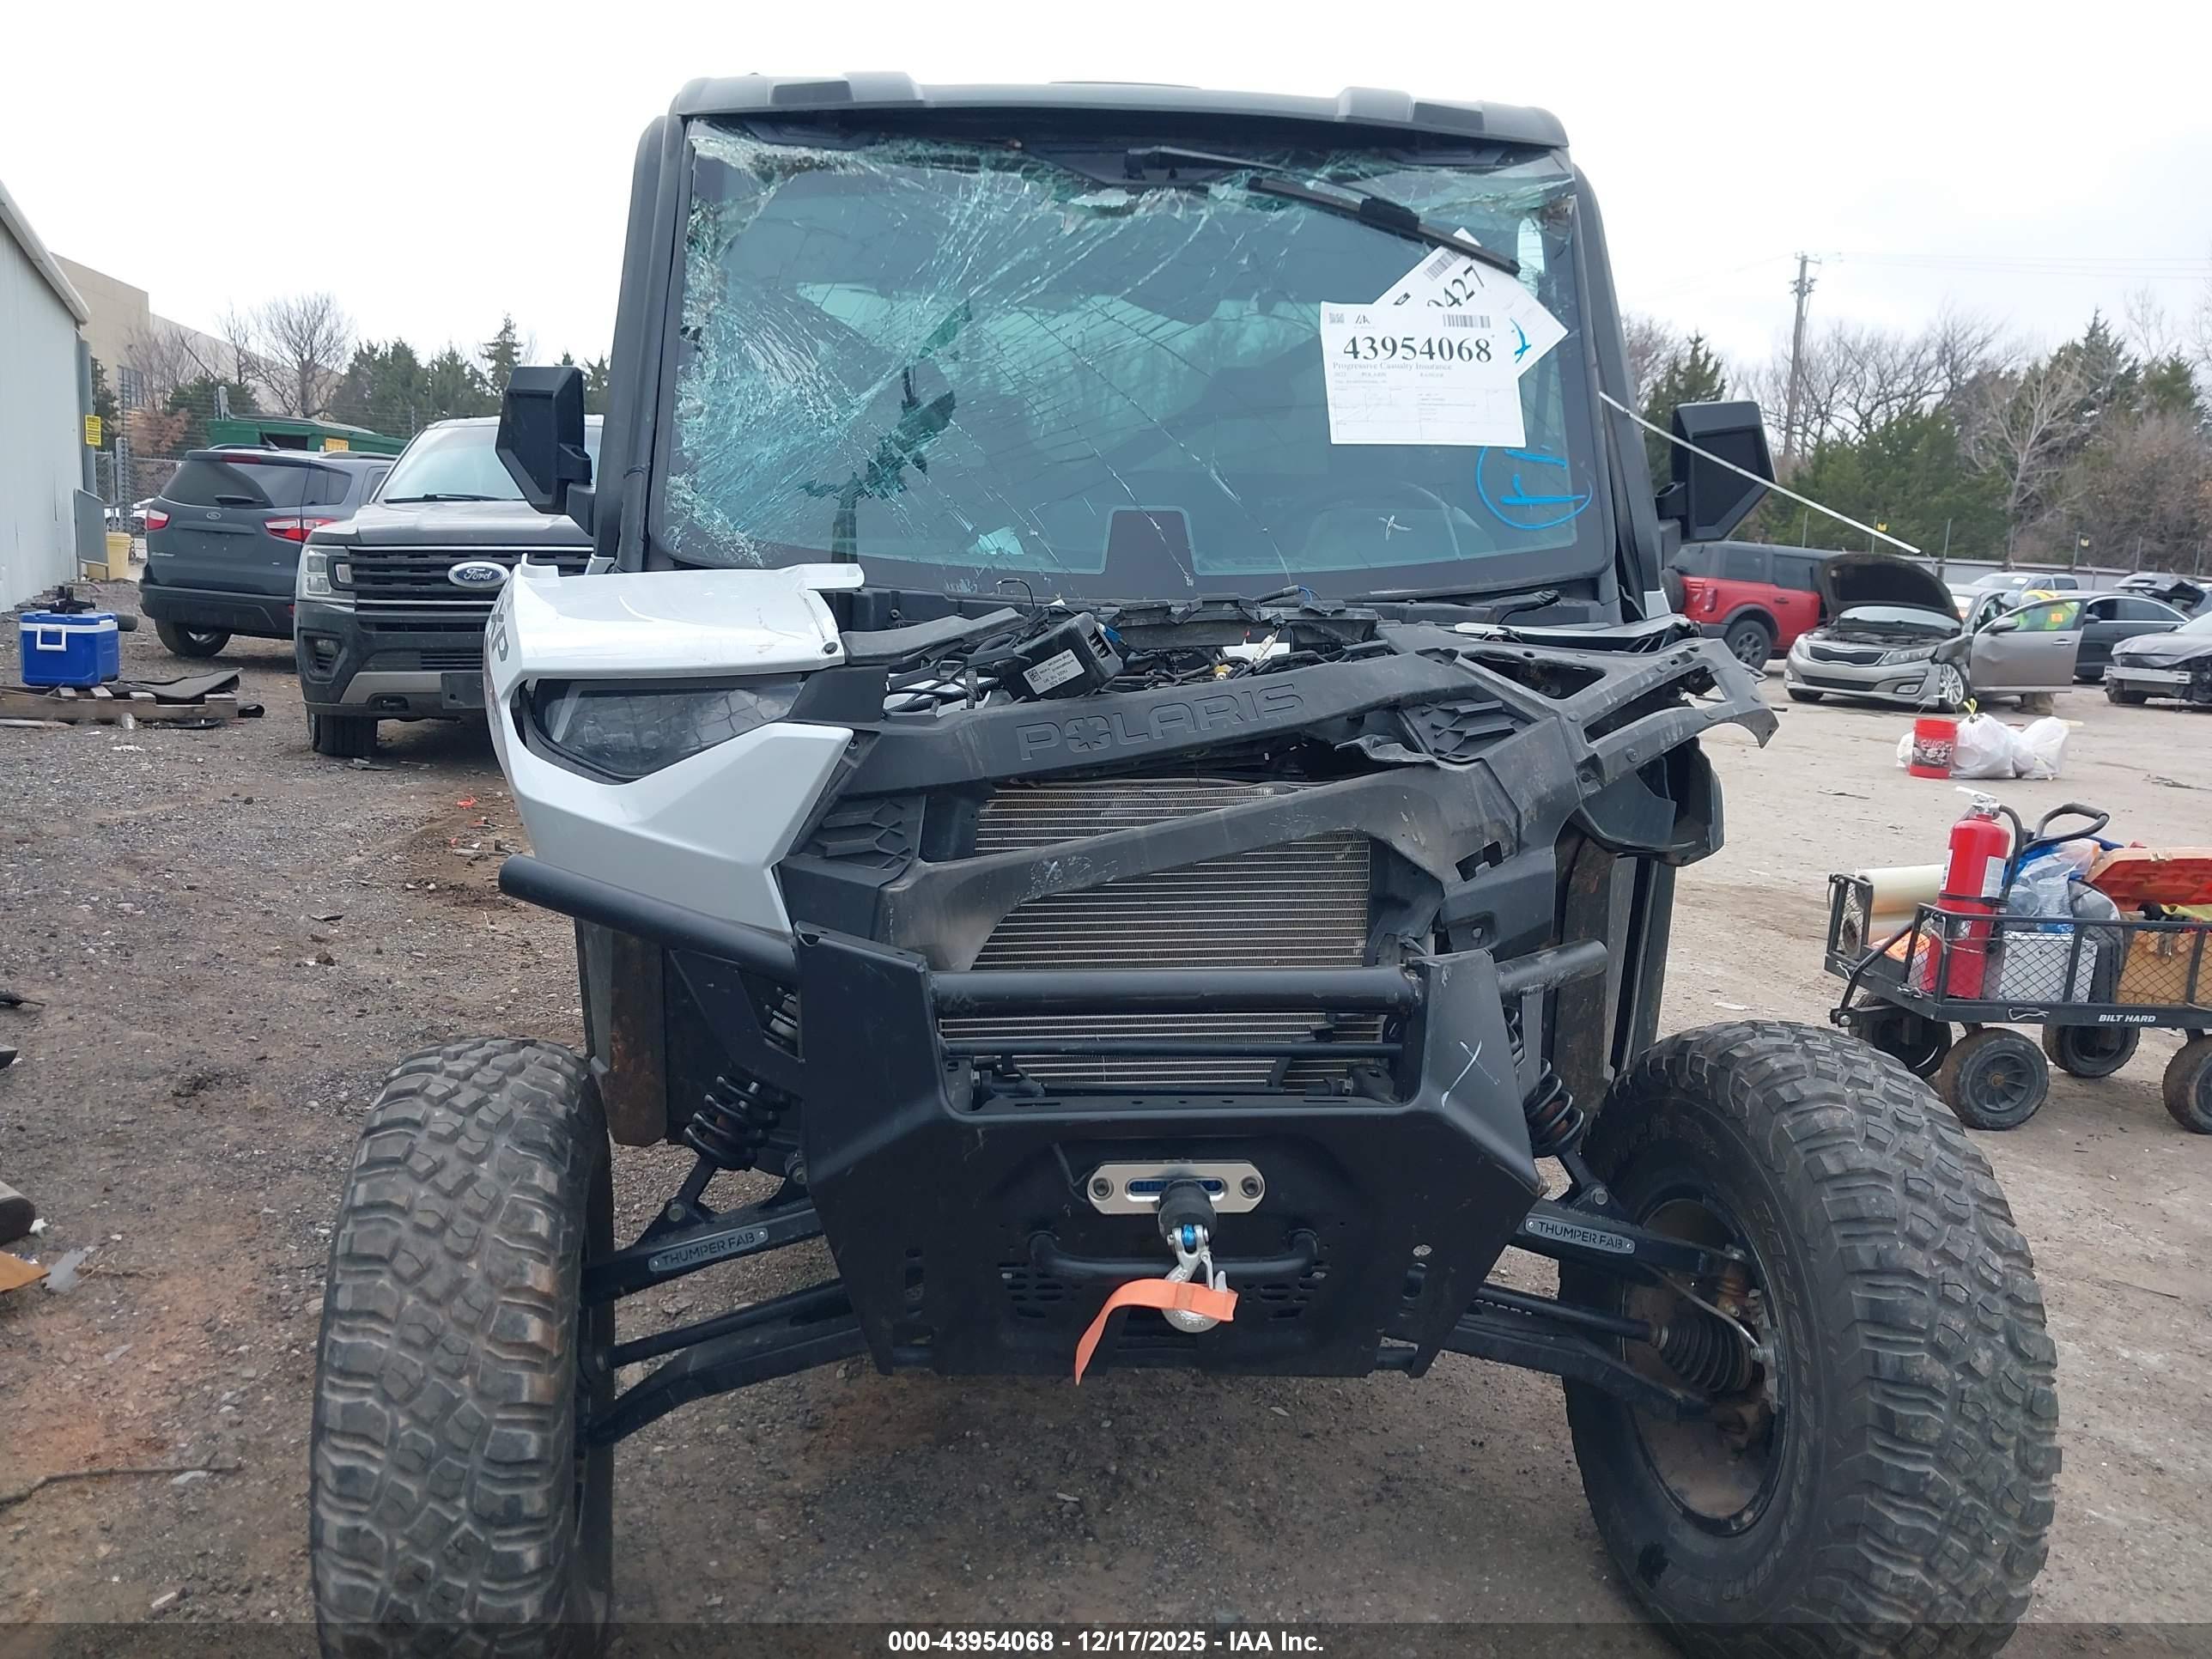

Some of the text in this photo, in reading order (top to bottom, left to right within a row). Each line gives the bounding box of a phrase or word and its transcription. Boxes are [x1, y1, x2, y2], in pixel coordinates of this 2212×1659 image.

[1343, 336, 1492, 362] 43954068
[464, 568, 493, 580] Ford
[1017, 683, 1304, 762] POLARIS
[2098, 1014, 2124, 1023] BILT
[661, 1231, 756, 1265] THUMPER FAB
[1538, 1221, 1623, 1249] THUMPER FAB
